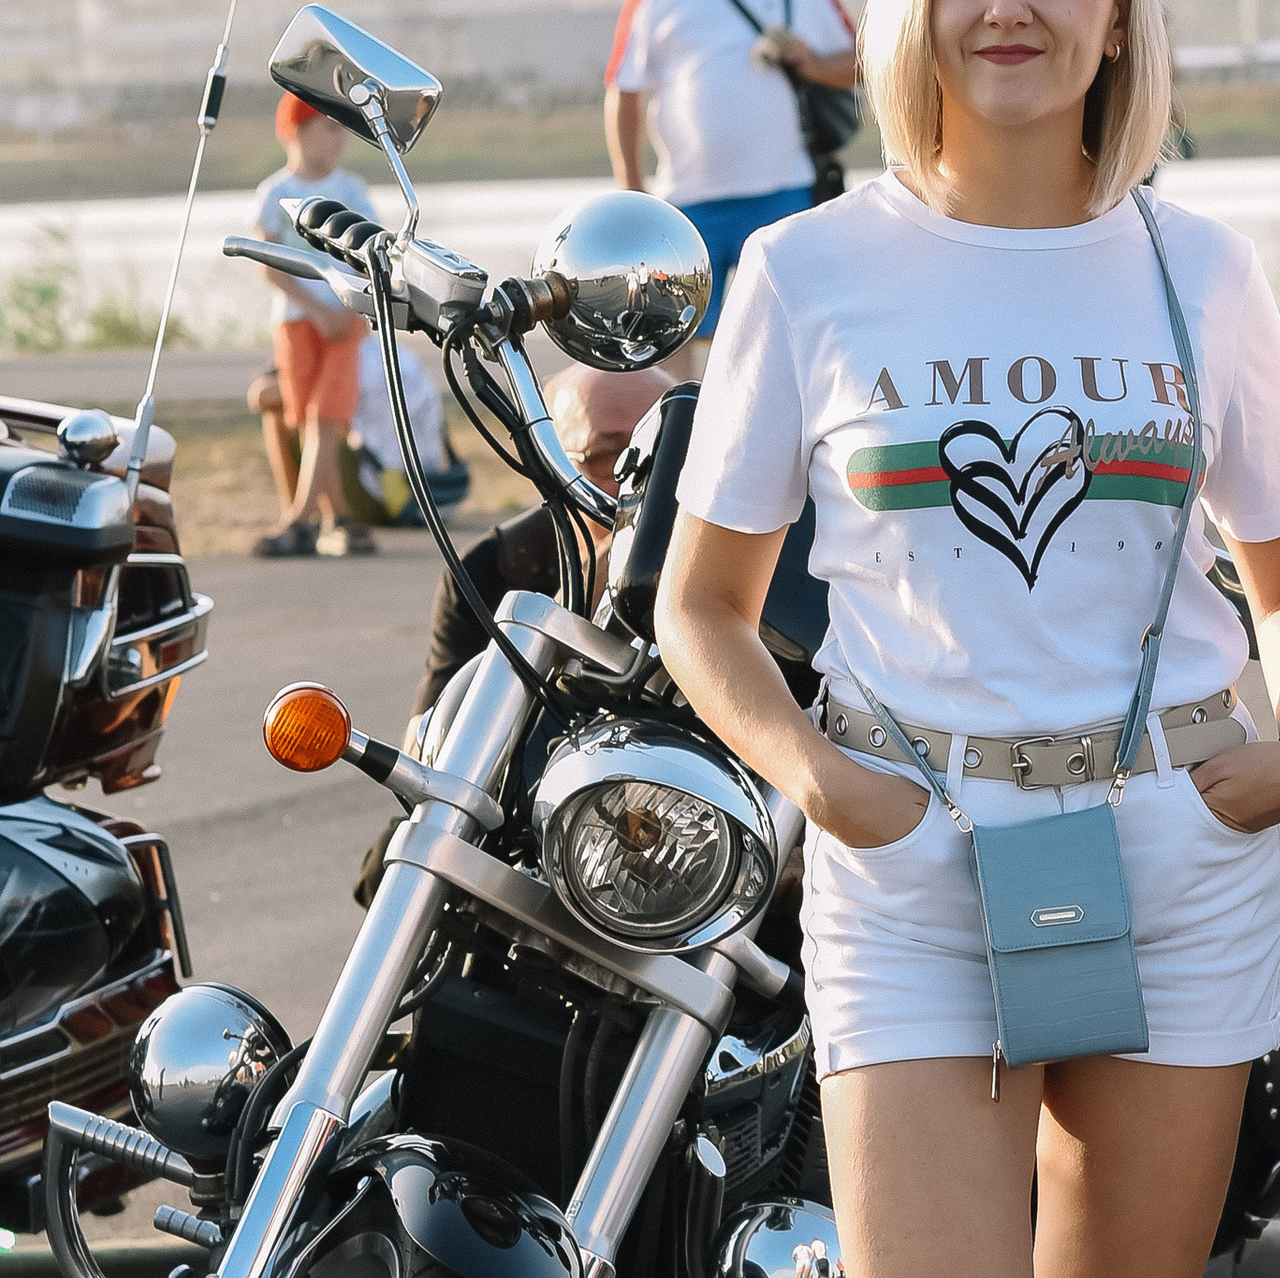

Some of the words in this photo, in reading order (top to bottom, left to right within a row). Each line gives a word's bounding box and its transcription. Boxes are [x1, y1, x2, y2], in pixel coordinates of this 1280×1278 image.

[856, 355, 1193, 416] AMOUR
[875, 547, 963, 563] EST
[1070, 540, 1163, 553] 198
